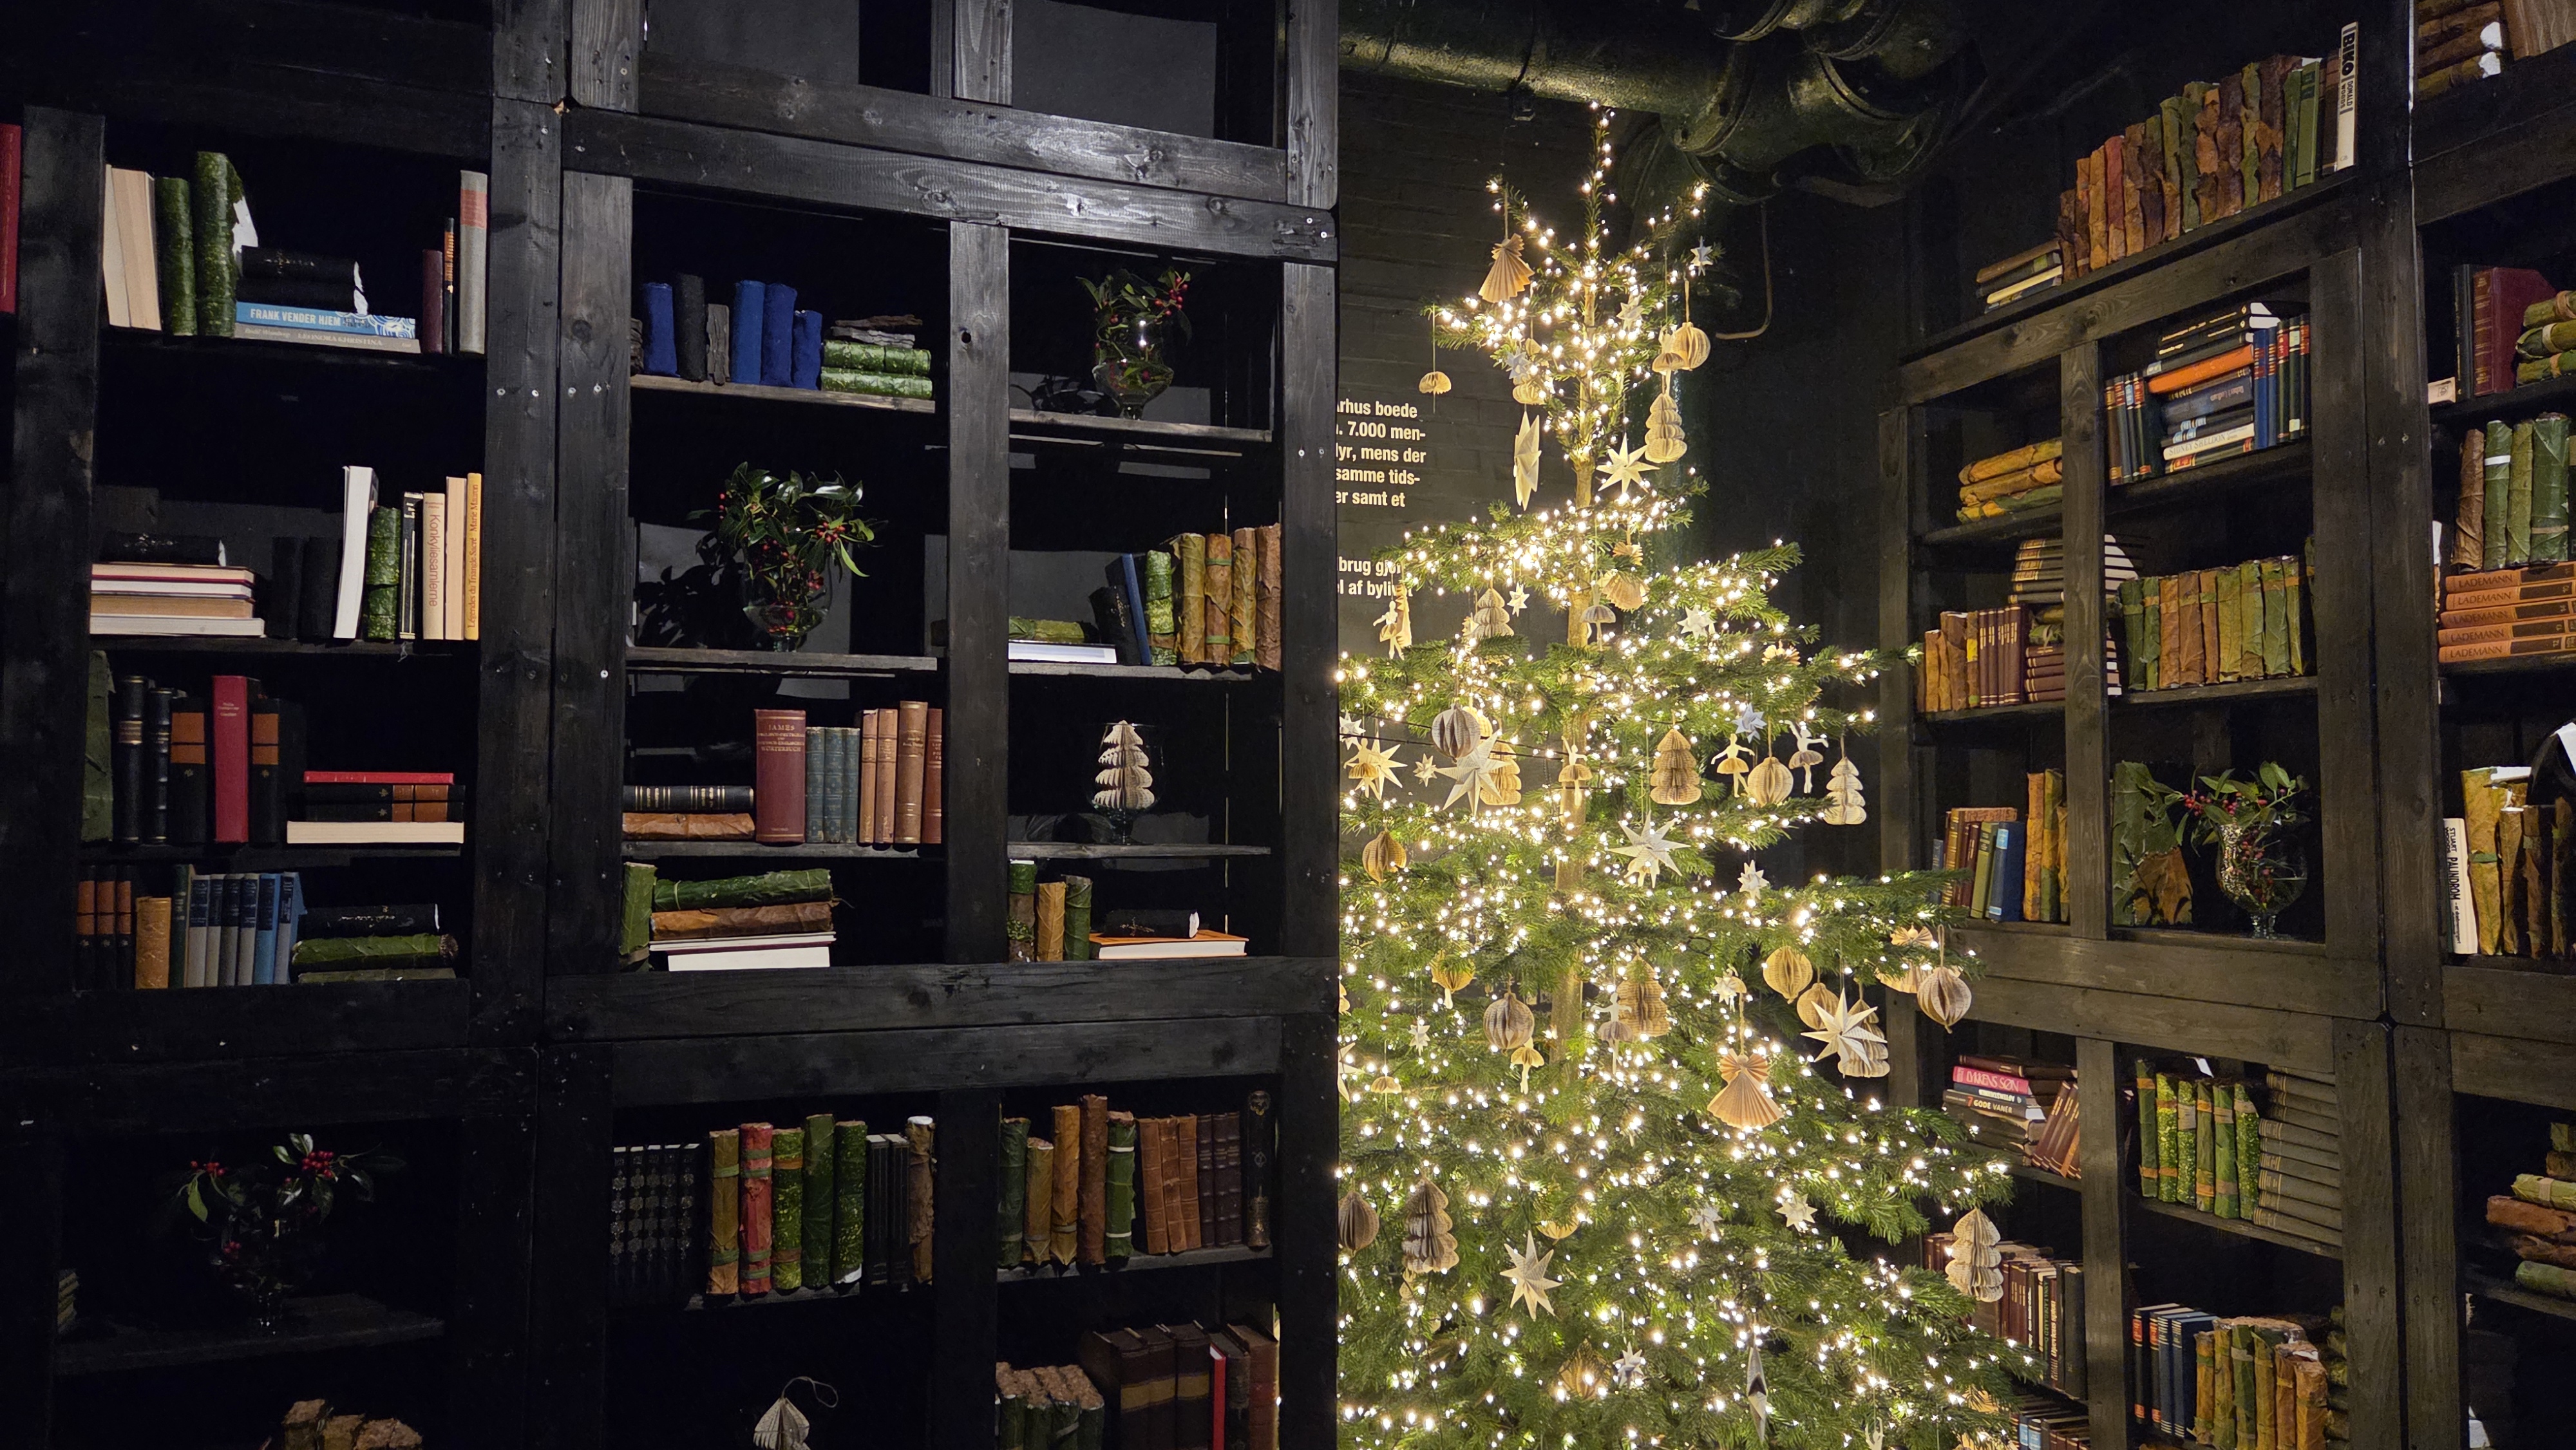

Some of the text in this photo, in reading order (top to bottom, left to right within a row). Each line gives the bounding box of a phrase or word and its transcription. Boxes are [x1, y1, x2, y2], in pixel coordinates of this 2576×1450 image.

[2342, 32, 2354, 76] BIKO
[251, 308, 279, 321] FRANK
[282, 311, 316, 325] VENDER
[318, 314, 341, 326] HJEM
[1375, 400, 1417, 419] boede
[1347, 420, 1386, 438] 7.000
[1390, 427, 1426, 440] men-
[2169, 434, 2226, 456] SIDNEY SHELDON
[1361, 447, 1399, 462] mens
[1403, 447, 1426, 463] der
[1336, 468, 1420, 485] samme tids-
[1352, 491, 1388, 506] samt
[1391, 492, 1405, 507] et
[468, 557, 477, 584] Triangle
[1337, 556, 1371, 576] brug
[469, 585, 477, 594] du
[1337, 579, 1344, 594] l
[1348, 579, 1363, 595] af
[2458, 574, 2512, 588] LADEMANN
[2458, 591, 2512, 605] LADEMANN
[468, 596, 477, 628] Légendes
[2453, 610, 2508, 624] LADEMANN
[2450, 629, 2505, 643] LADEMANN
[2450, 646, 2503, 658] LADEMANN
[2448, 827, 2457, 852] STUART
[2447, 857, 2461, 900] PALINDROM
[1999, 1077, 2020, 1093] SØN
[1967, 1096, 1974, 1107] 7
[1973, 1099, 1991, 1109] GODE
[1993, 1104, 2012, 1114] VANER
